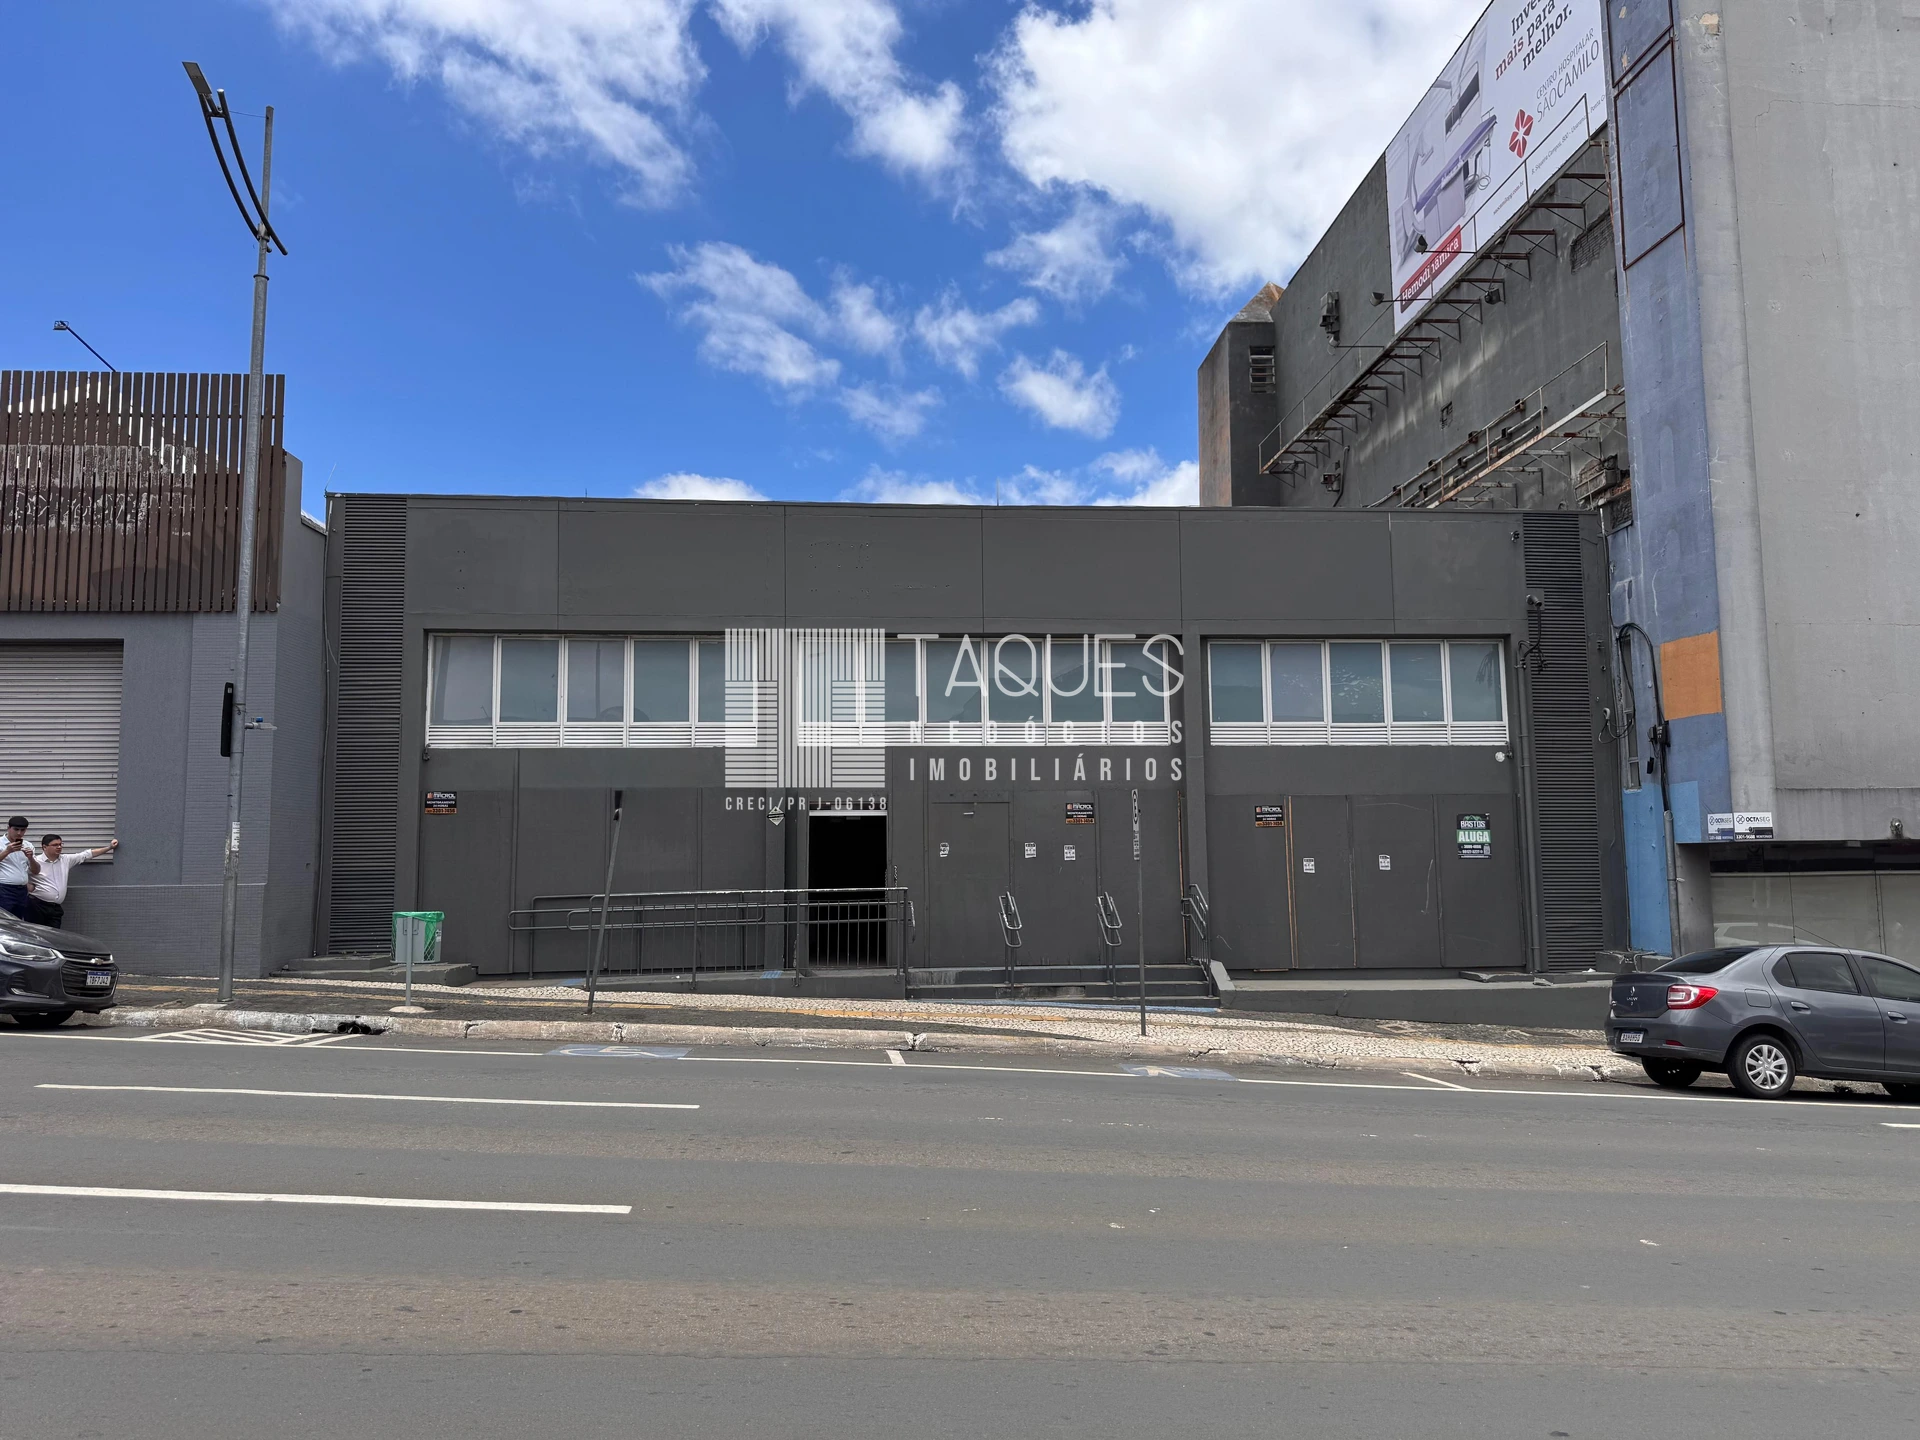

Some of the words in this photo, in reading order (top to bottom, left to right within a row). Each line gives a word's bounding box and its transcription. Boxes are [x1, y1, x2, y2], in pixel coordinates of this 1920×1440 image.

[1495, 36, 1525, 81] mais
[1526, 0, 1556, 46] para
[1511, 0, 1546, 36] Inve
[1522, 3, 1573, 71] melhor.
[1536, 70, 1558, 100] CENTRO
[1558, 27, 1594, 74] HOSPITALAR
[1458, 831, 1490, 842] ALUGA
[1460, 820, 1486, 828] BASTOS
